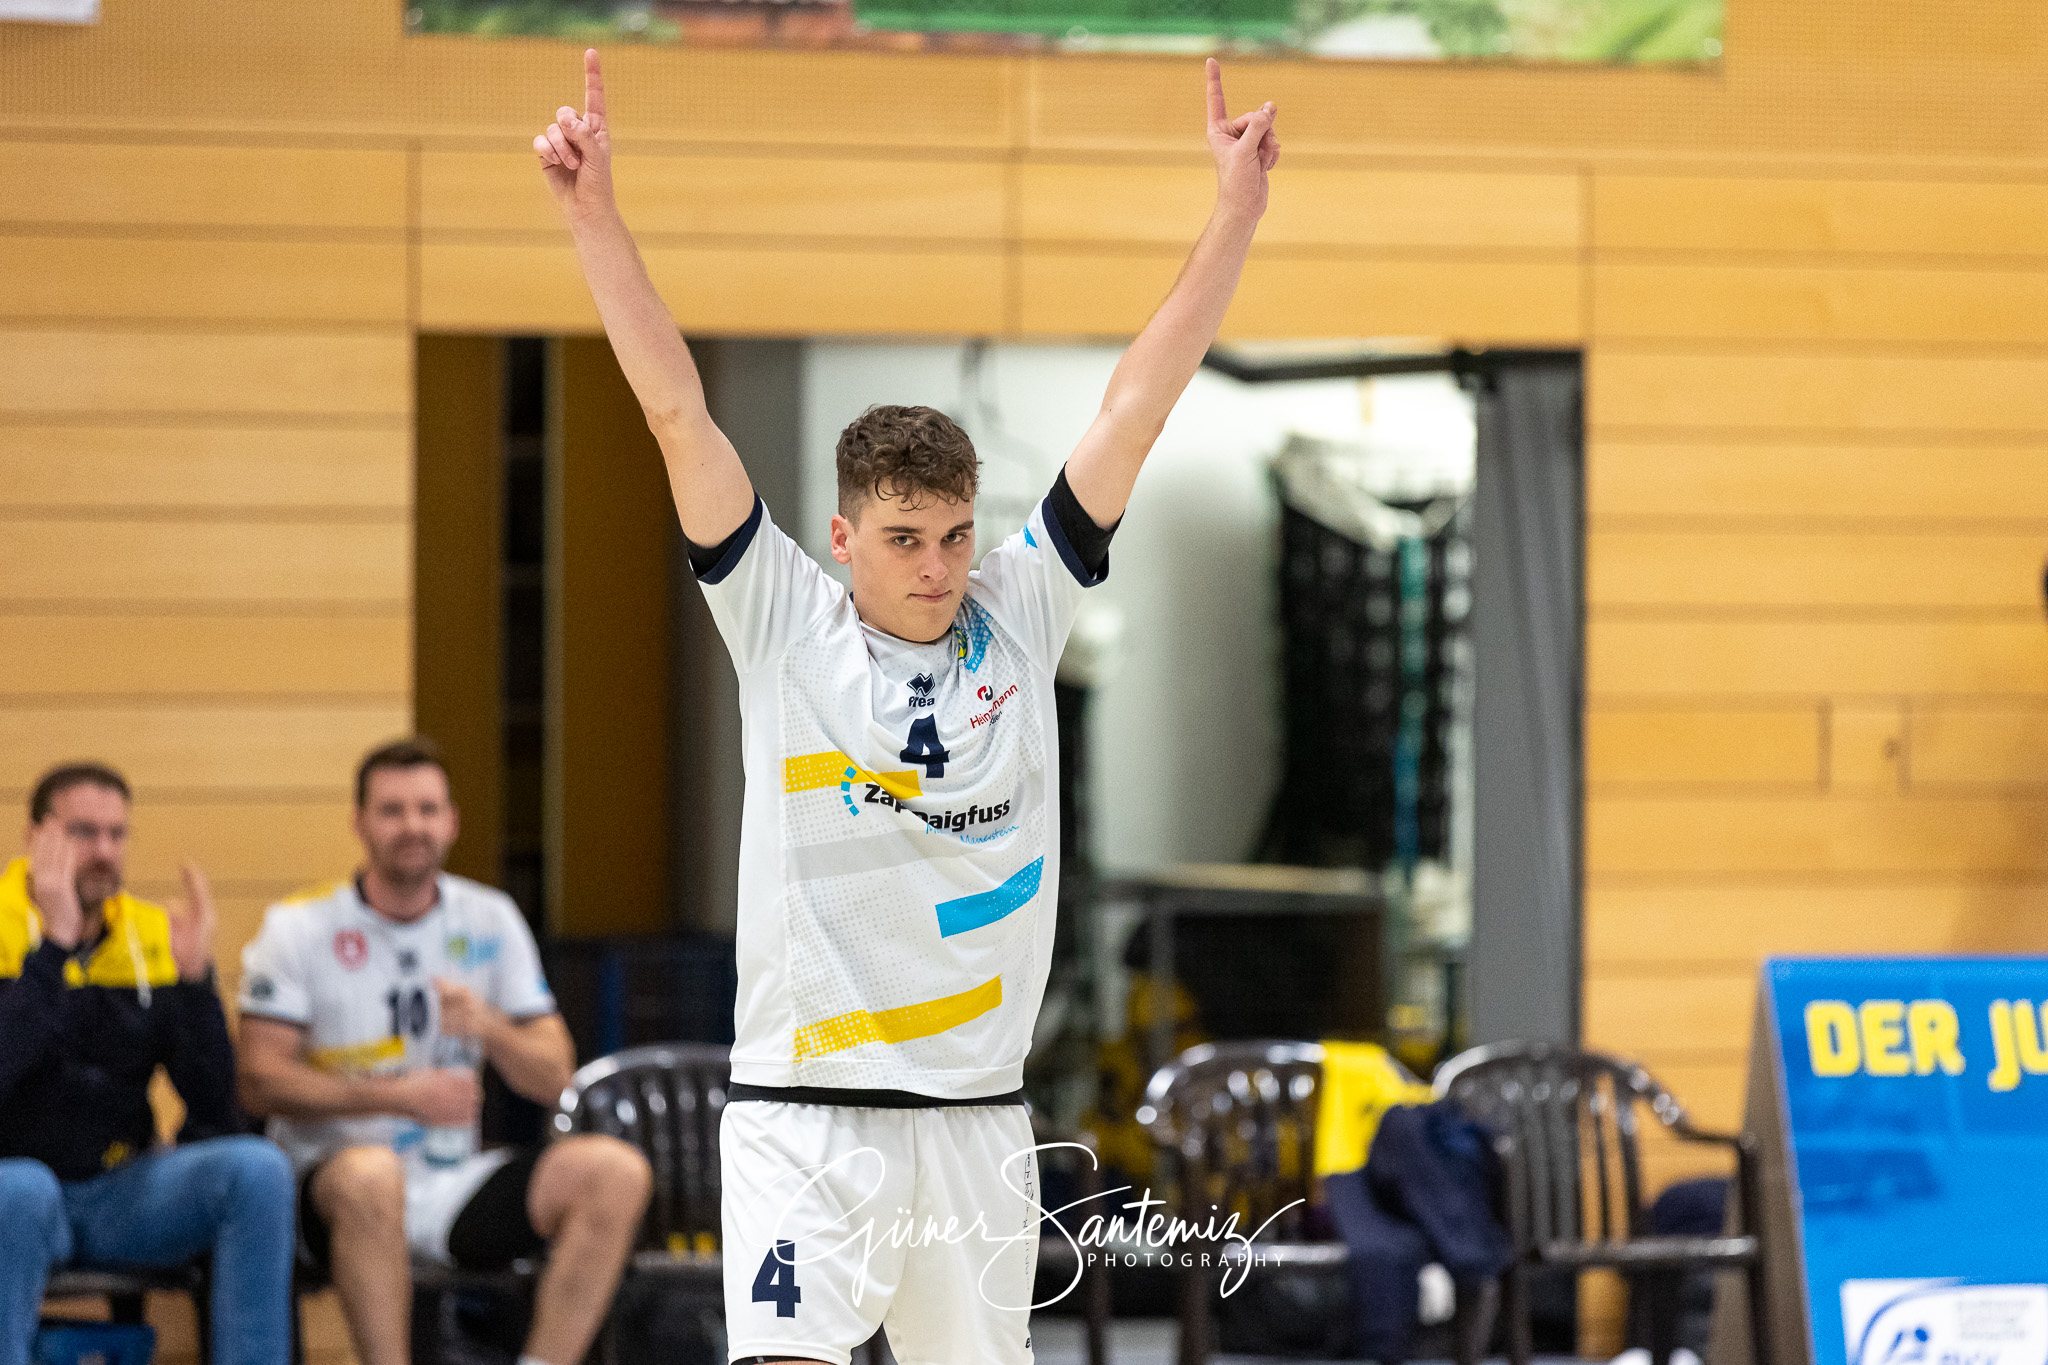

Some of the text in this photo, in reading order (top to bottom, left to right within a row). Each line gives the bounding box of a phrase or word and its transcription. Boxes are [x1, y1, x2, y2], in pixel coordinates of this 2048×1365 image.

[899, 713, 950, 778] 4
[385, 984, 429, 1040] 10
[1805, 1000, 1966, 1077] DER
[752, 1239, 801, 1318] 4
